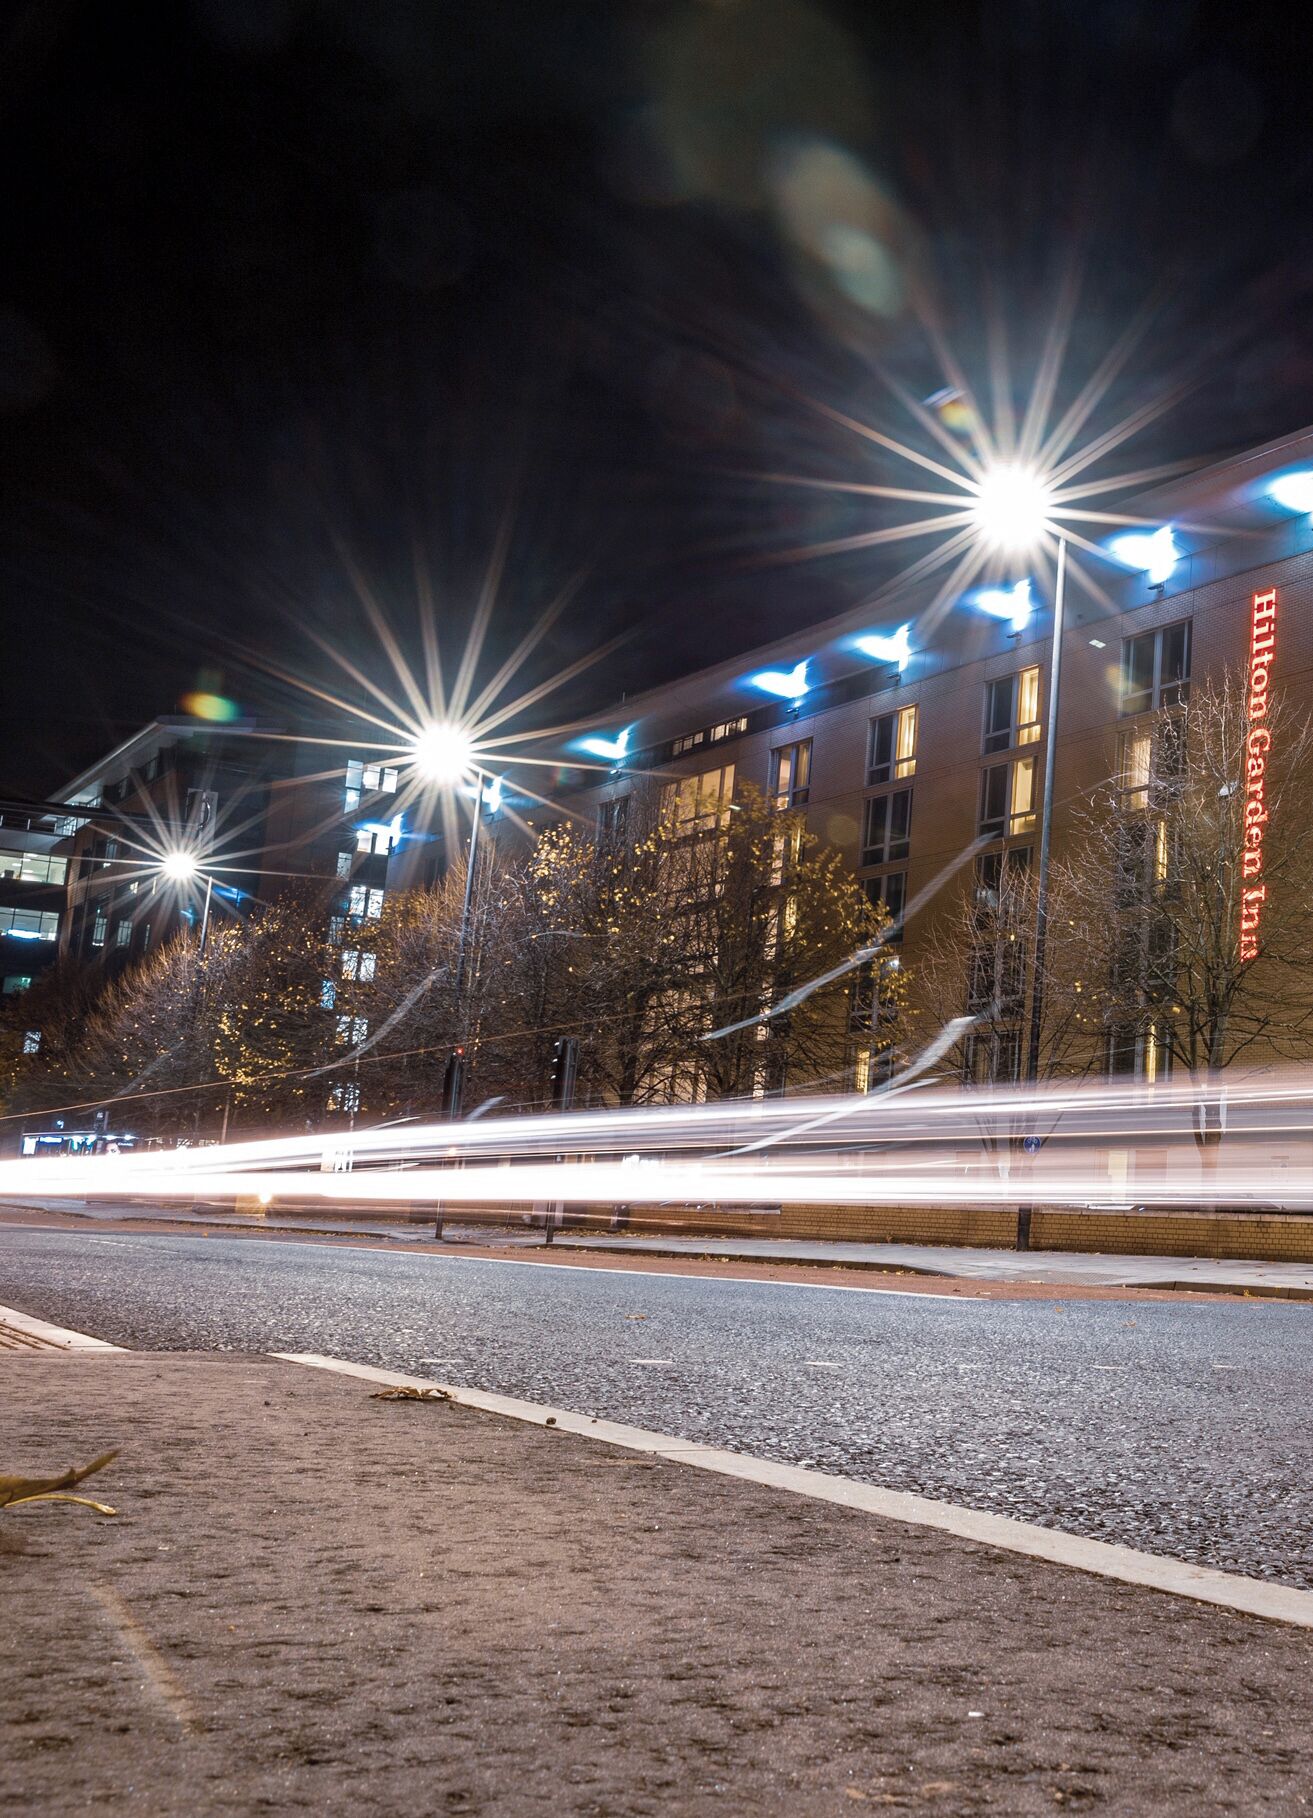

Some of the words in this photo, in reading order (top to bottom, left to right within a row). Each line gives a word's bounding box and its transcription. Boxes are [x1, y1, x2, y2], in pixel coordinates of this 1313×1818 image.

[1249, 588, 1277, 719] Hilton
[1243, 728, 1271, 878] Garden
[1240, 886, 1265, 963] Inn
